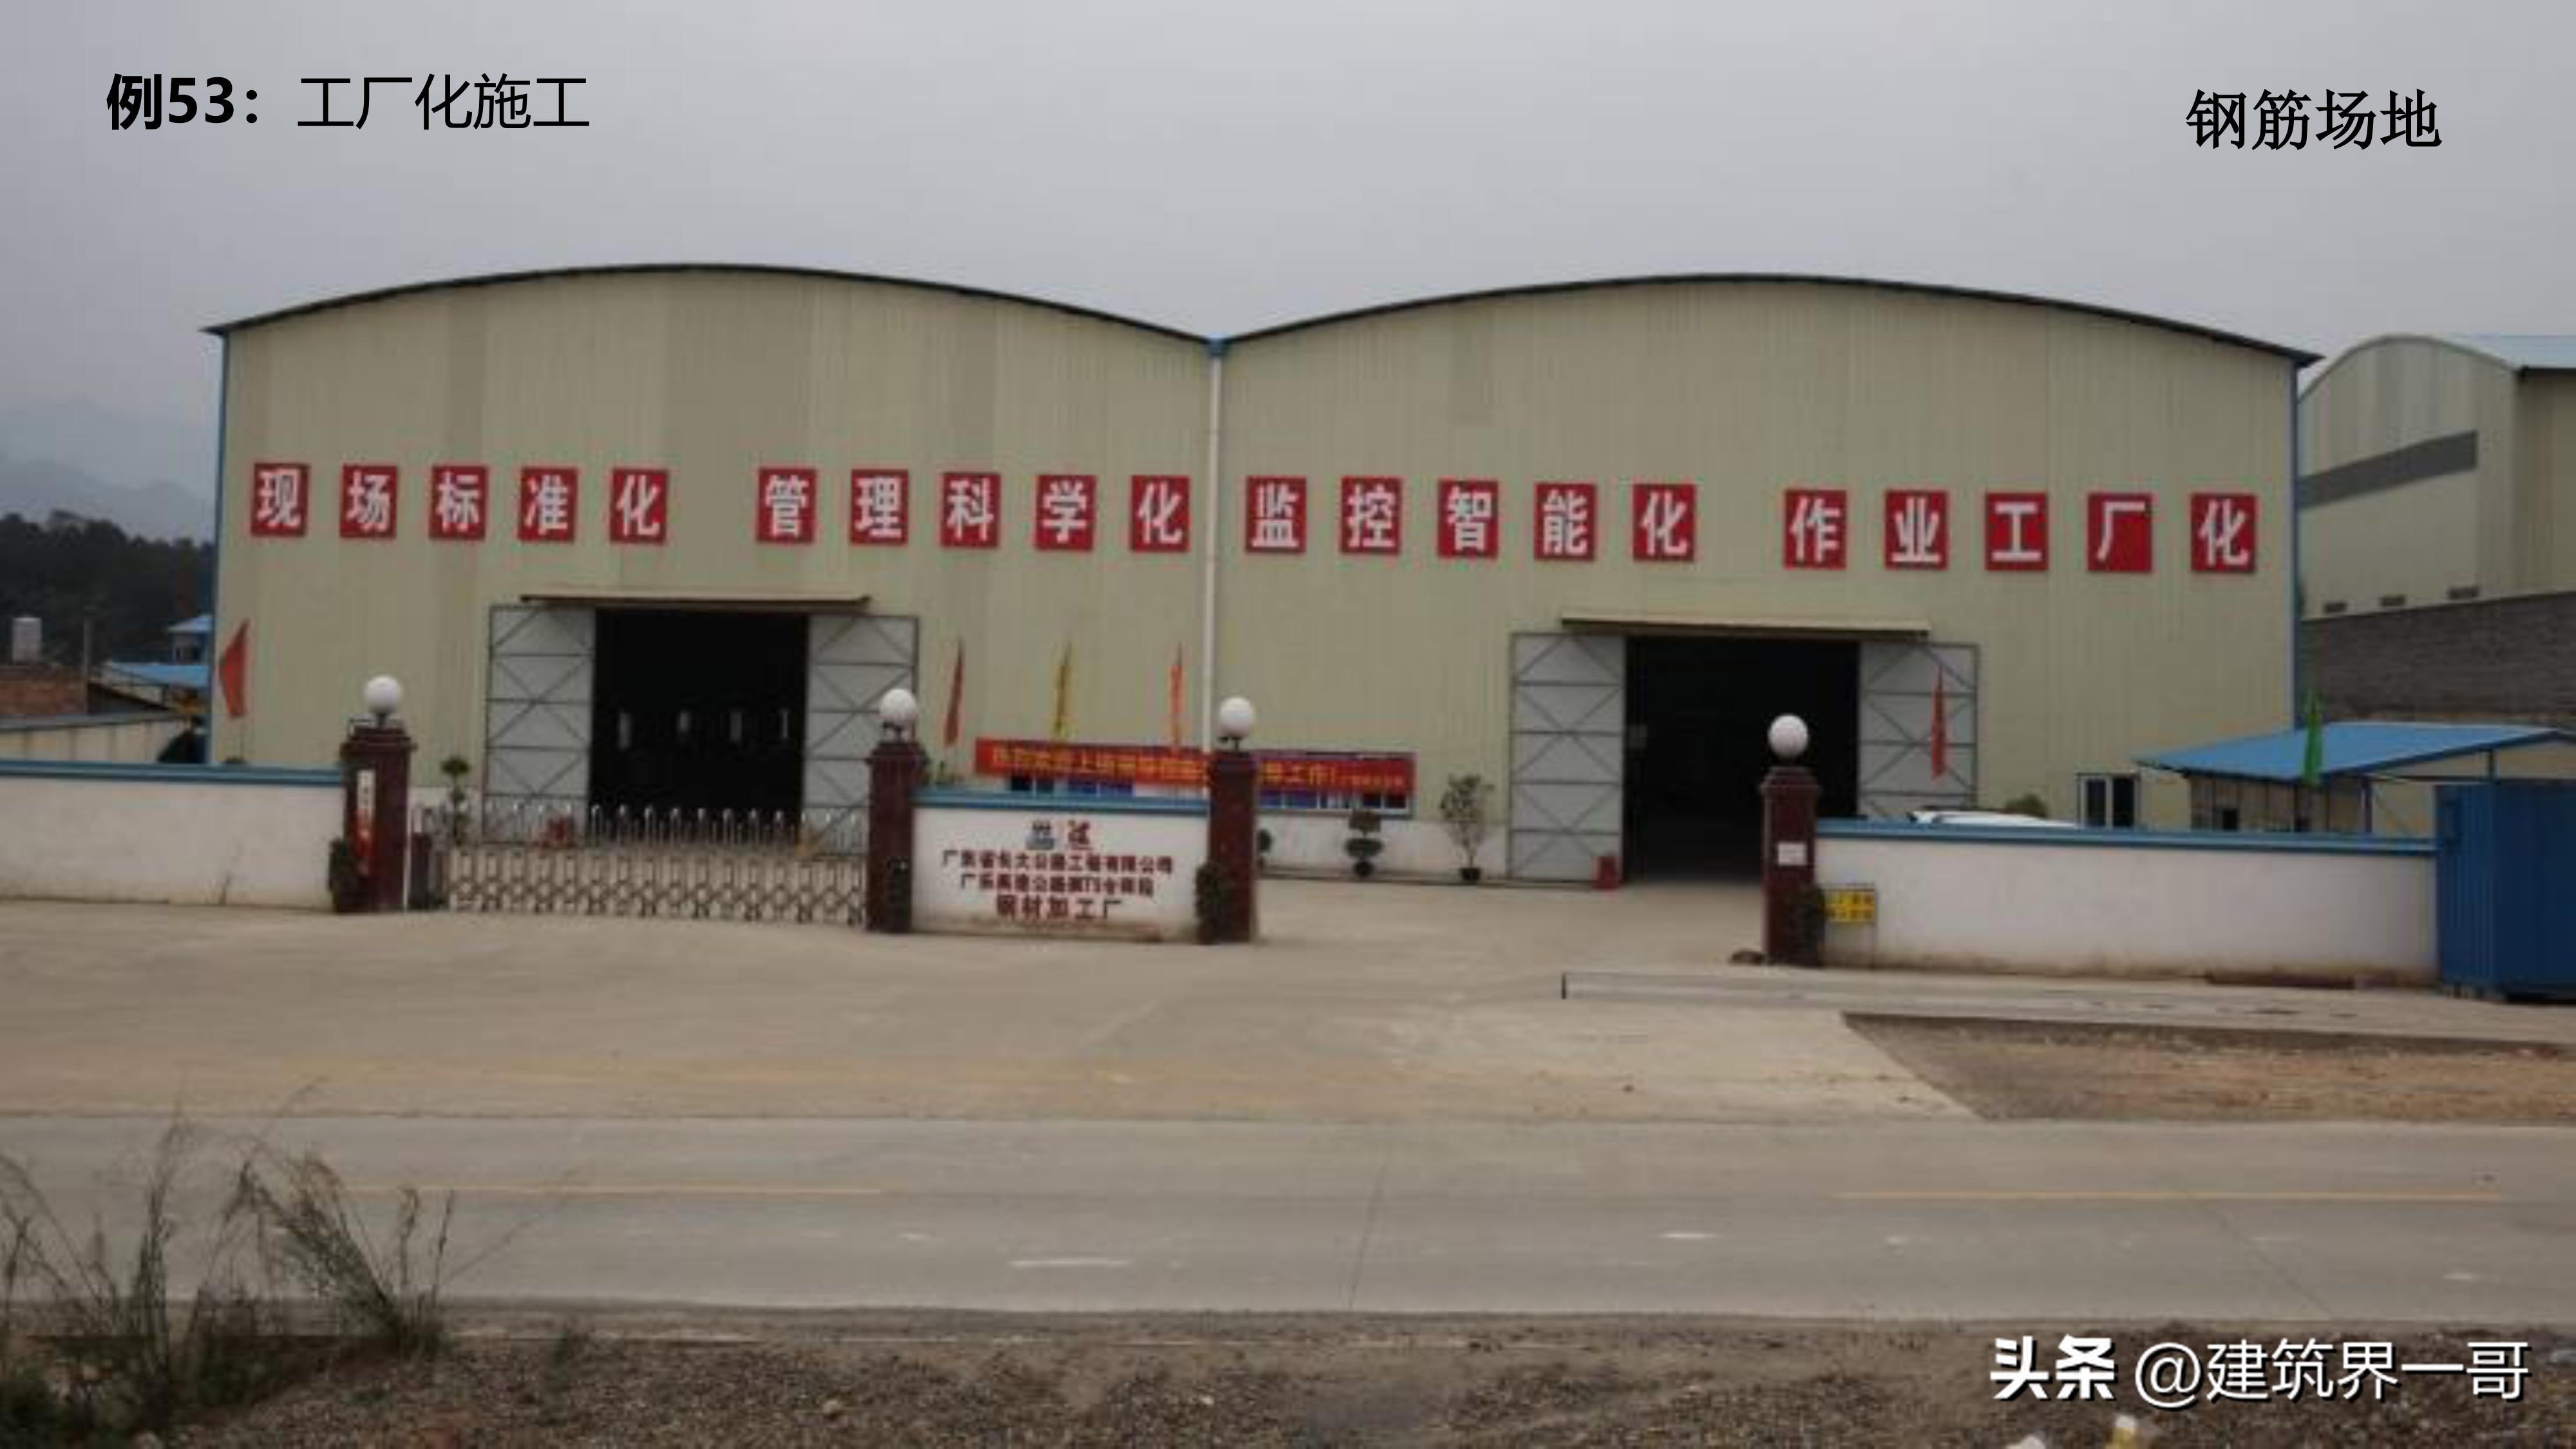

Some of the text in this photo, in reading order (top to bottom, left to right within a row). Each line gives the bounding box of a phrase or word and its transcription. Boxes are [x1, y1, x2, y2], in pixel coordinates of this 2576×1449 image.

[256, 469, 2249, 567] 现场标准化 管理科学化 监控智能化 作业工厂化
[996, 895, 1122, 919] 钢材加工厂
